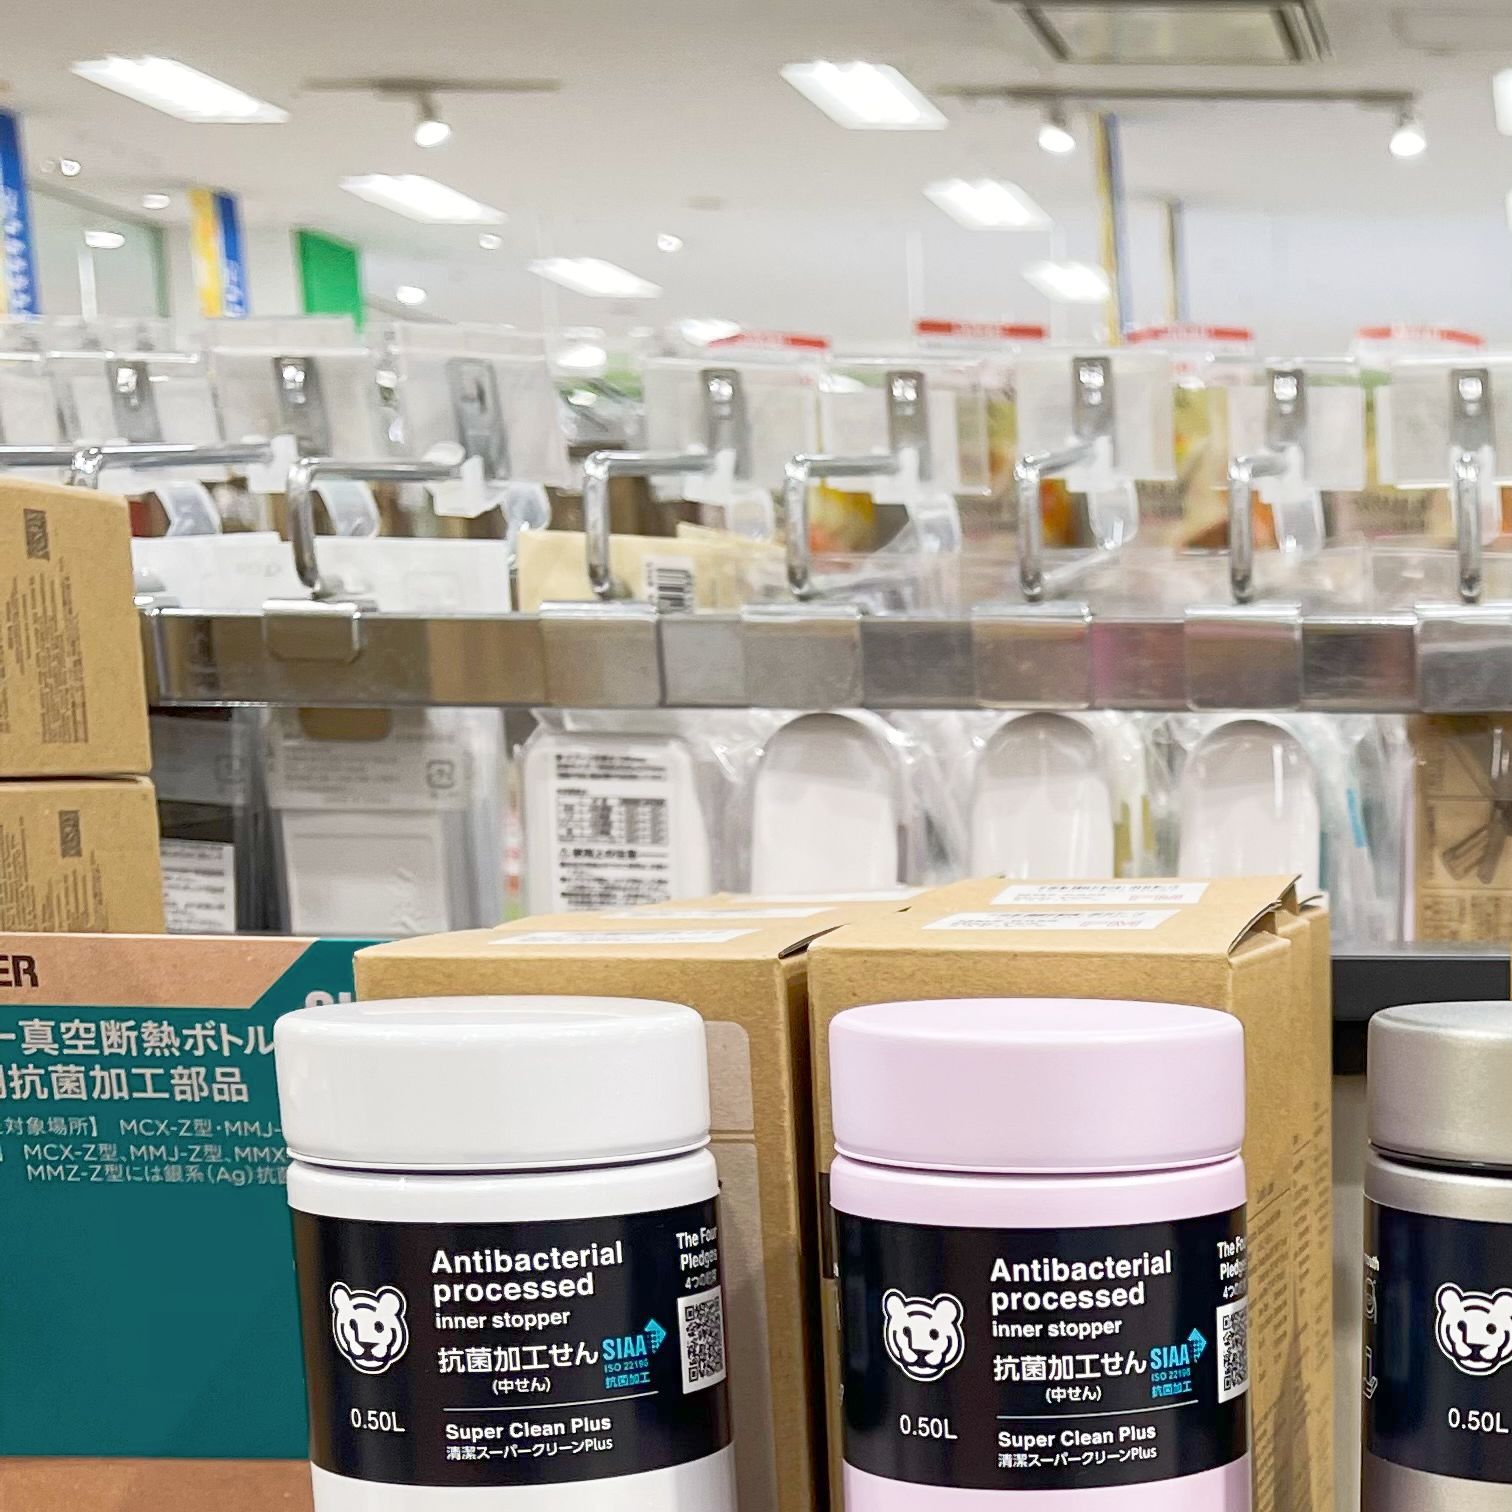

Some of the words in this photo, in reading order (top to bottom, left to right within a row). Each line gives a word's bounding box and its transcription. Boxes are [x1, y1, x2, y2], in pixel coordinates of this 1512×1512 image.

[0, 1063, 249, 1103] 抗菌加工部品
[676, 1231, 699, 1249] The
[431, 1241, 623, 1274] Antibacterial
[990, 1251, 1172, 1282] Antibacterial
[433, 1273, 595, 1307] processed
[992, 1282, 1145, 1315] processed
[435, 1314, 487, 1329] inner
[491, 1309, 570, 1330] stopper
[992, 1322, 1043, 1338] inner
[1048, 1319, 1122, 1339] stopper
[438, 1342, 598, 1373] 抗菌加工せん
[602, 1336, 647, 1360] SIAA
[1150, 1344, 1190, 1370] SIAA
[993, 1351, 1147, 1381] 抗菌加工せん
[492, 1378, 551, 1395] (中せん)
[1045, 1386, 1102, 1403] (中せん)
[350, 1407, 405, 1432] 0.50L
[445, 1423, 503, 1442] Super
[509, 1420, 565, 1437] Clean
[570, 1415, 611, 1432] Plus
[899, 1415, 958, 1440] 0.50L
[1448, 1407, 1509, 1434] 0.50L
[998, 1430, 1056, 1449] Super
[1060, 1429, 1114, 1445] Clean
[1119, 1425, 1156, 1441] Plus
